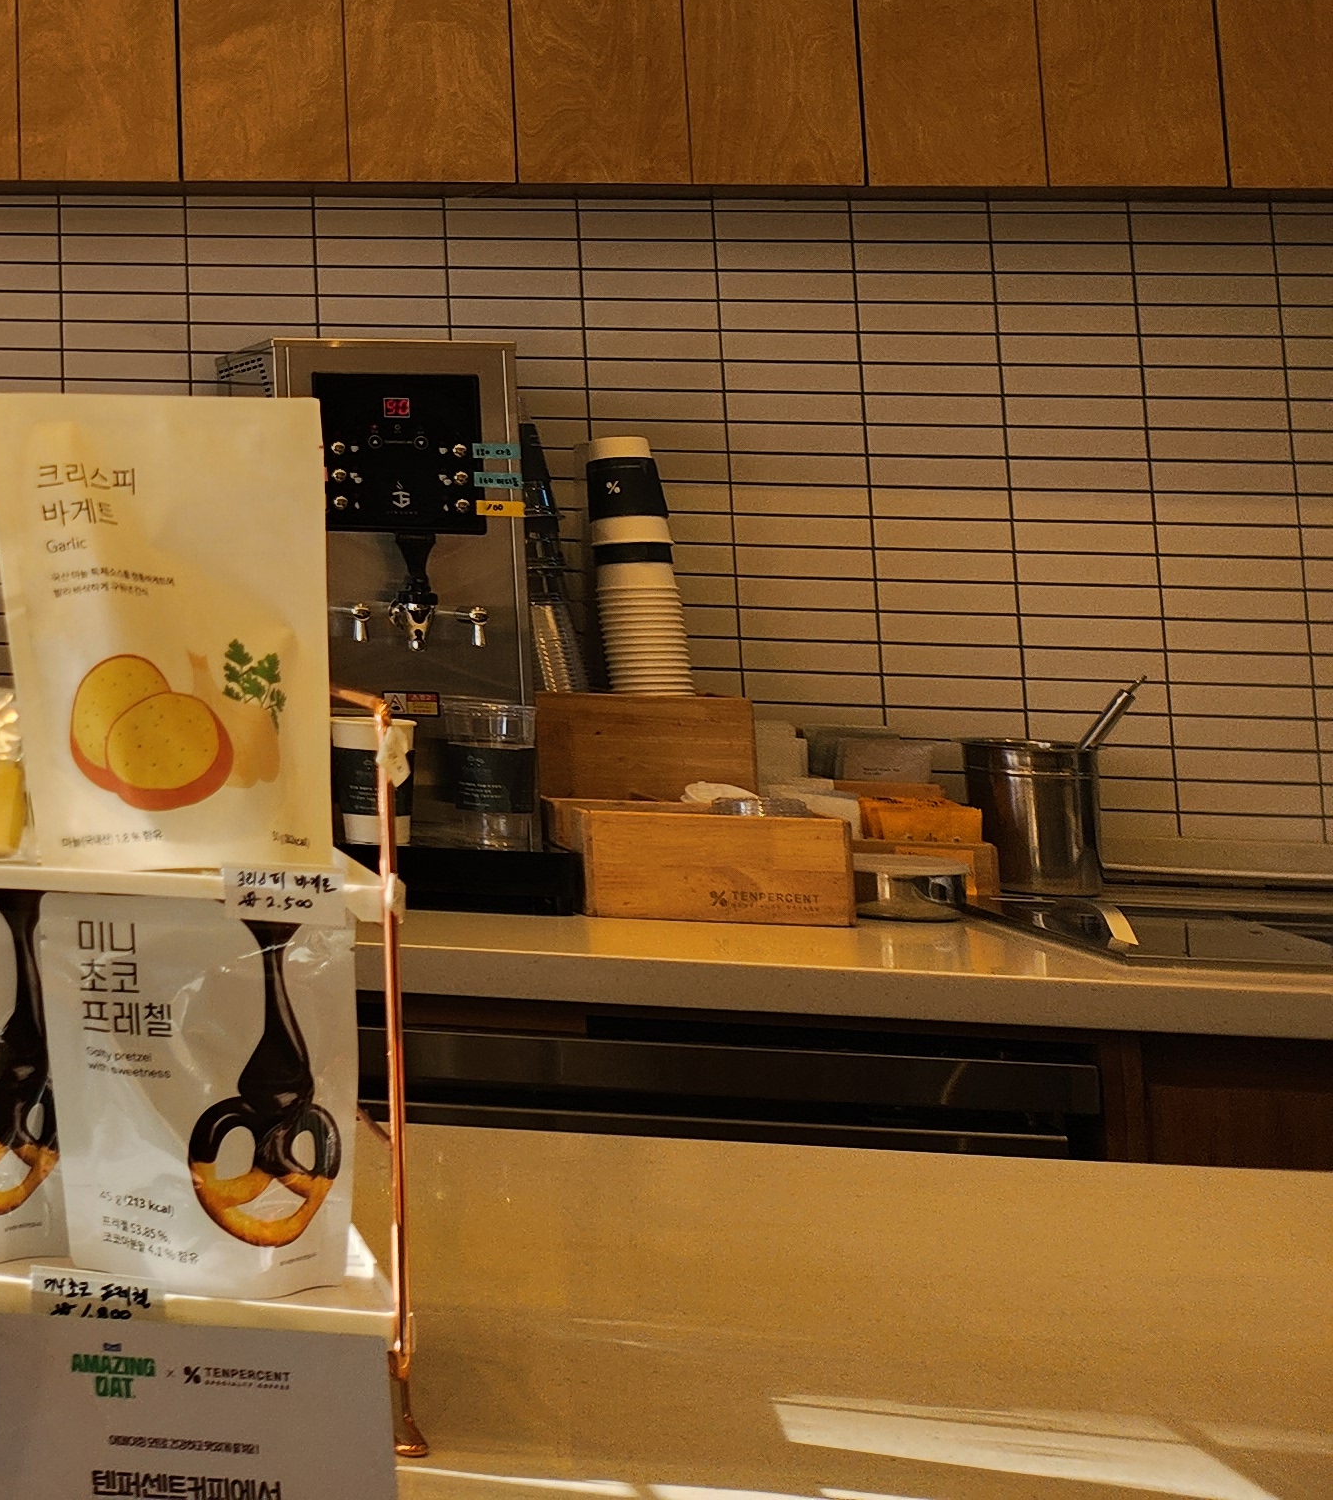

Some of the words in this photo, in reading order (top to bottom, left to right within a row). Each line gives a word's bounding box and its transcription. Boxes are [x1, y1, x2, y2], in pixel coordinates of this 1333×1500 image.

[37, 463, 136, 496] 크리스피
[42, 497, 118, 527] 바게트
[45, 537, 88, 554] Garlic
[731, 890, 819, 905] TENPERCENT
[78, 920, 136, 955] 미니
[80, 958, 140, 994] 초코
[82, 1000, 174, 1038] 프레첼
[114, 1051, 152, 1063] pretzel
[87, 1062, 108, 1073] with
[111, 1066, 172, 1080] sweetness
[148, 1199, 175, 1218] kcal)
[71, 1353, 157, 1377] AMAZING
[205, 1366, 291, 1384] TENPERCENT
